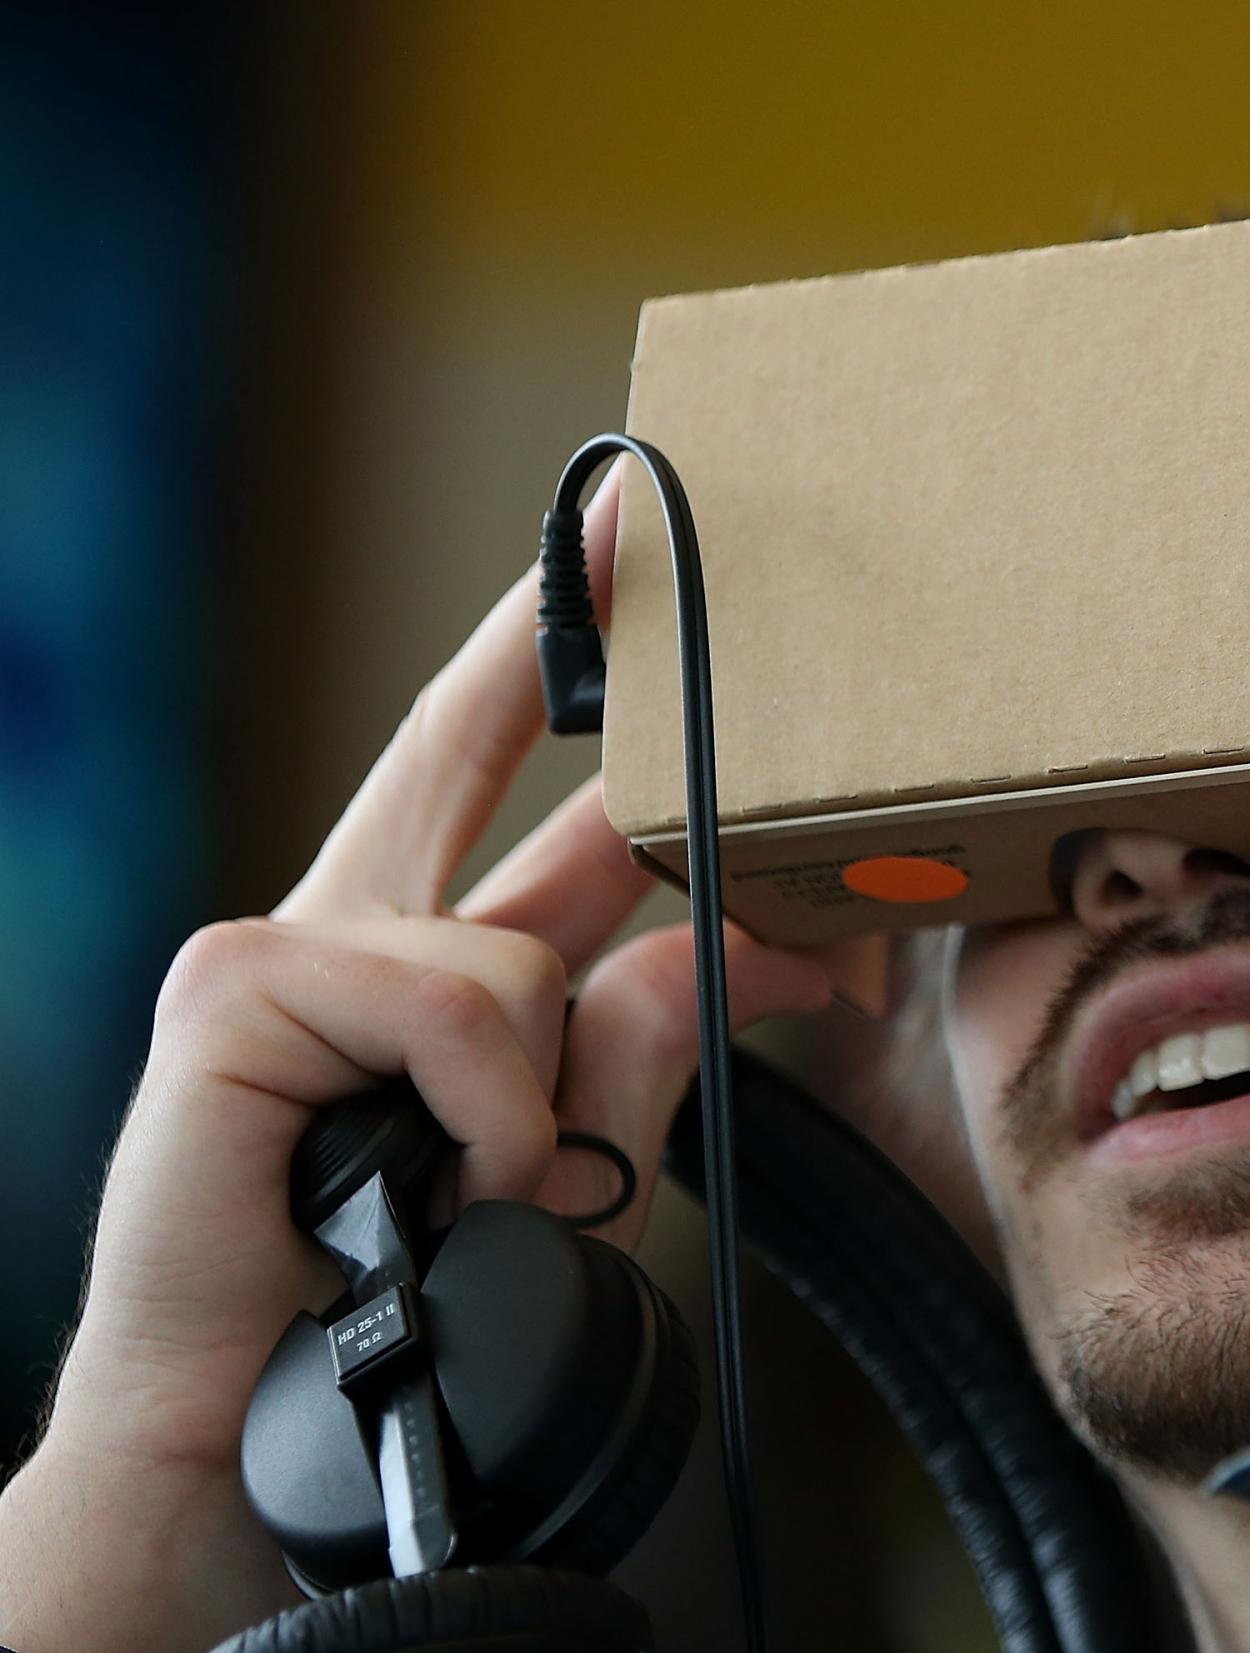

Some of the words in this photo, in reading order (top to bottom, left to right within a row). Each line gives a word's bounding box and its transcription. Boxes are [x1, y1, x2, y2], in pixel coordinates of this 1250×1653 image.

[337, 1328, 356, 1346] HD
[357, 1311, 383, 1334] 25-1
[385, 1303, 395, 1317] II
[356, 1338, 371, 1352] 70
[371, 1331, 383, 1344] Ω
